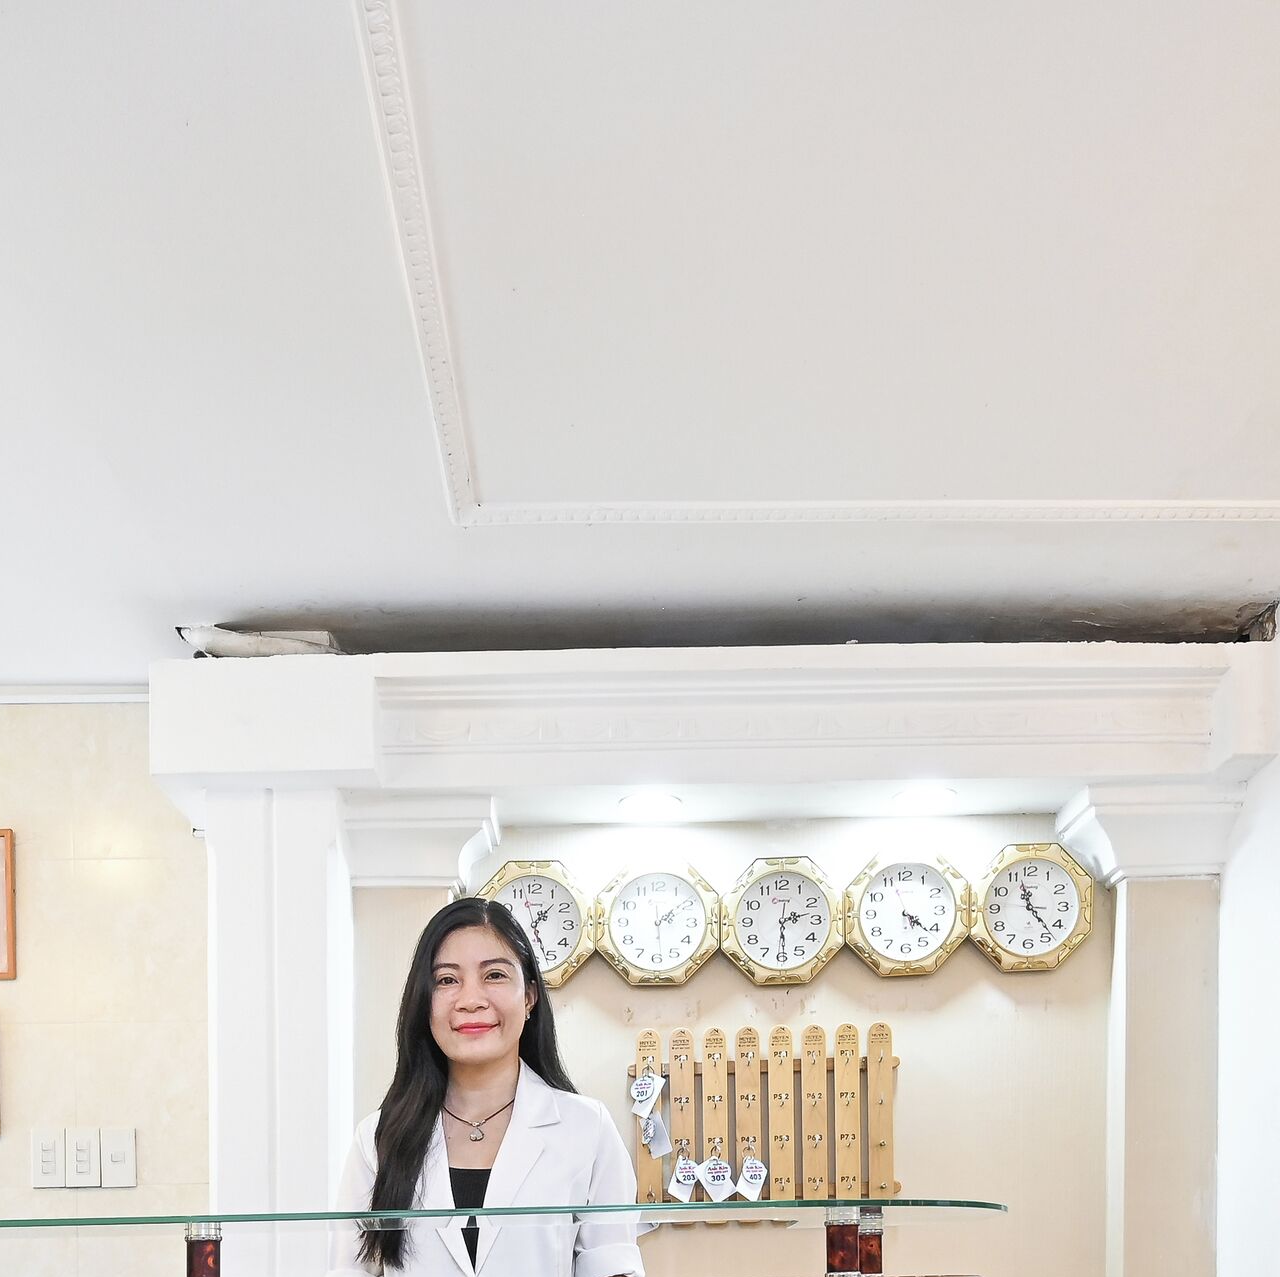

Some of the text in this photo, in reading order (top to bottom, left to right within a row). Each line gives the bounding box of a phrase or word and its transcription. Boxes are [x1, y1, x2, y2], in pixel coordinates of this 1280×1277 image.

[775, 880, 789, 890] 12
[746, 900, 760, 910] 10
[810, 915, 822, 925] 3
[747, 935, 758, 944] 8
